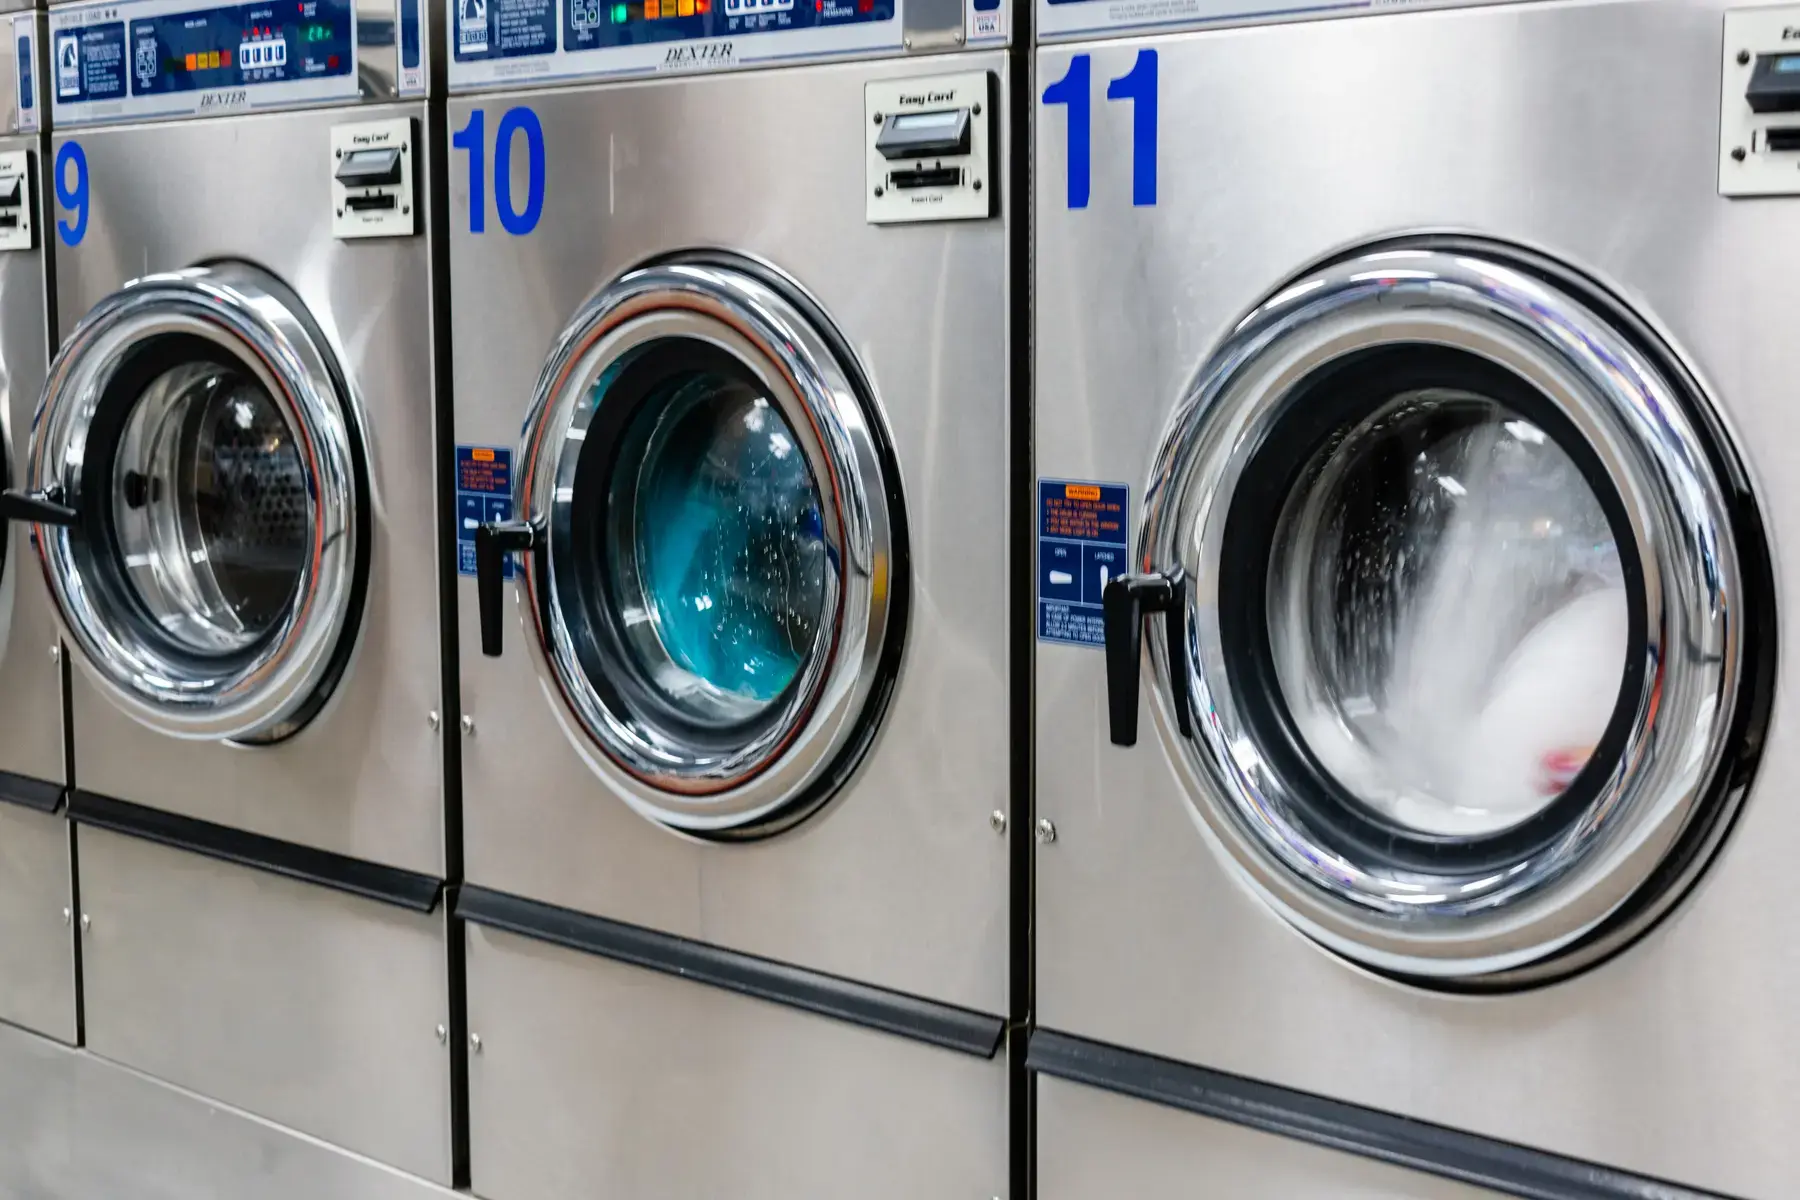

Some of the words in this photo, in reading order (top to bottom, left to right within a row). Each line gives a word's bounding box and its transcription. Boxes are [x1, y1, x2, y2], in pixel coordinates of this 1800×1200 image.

[978, 22, 995, 31] USA
[664, 42, 733, 61] DEXTER
[201, 91, 246, 106] DEXTER
[899, 93, 925, 105] Easy
[927, 90, 954, 102] Card
[1042, 49, 1158, 208] 11
[453, 107, 545, 235] 10
[54, 141, 89, 247] 9
[1068, 489, 1098, 497] WARNING
[1055, 548, 1067, 557] OPEN
[1094, 552, 1114, 562] LATCHED
